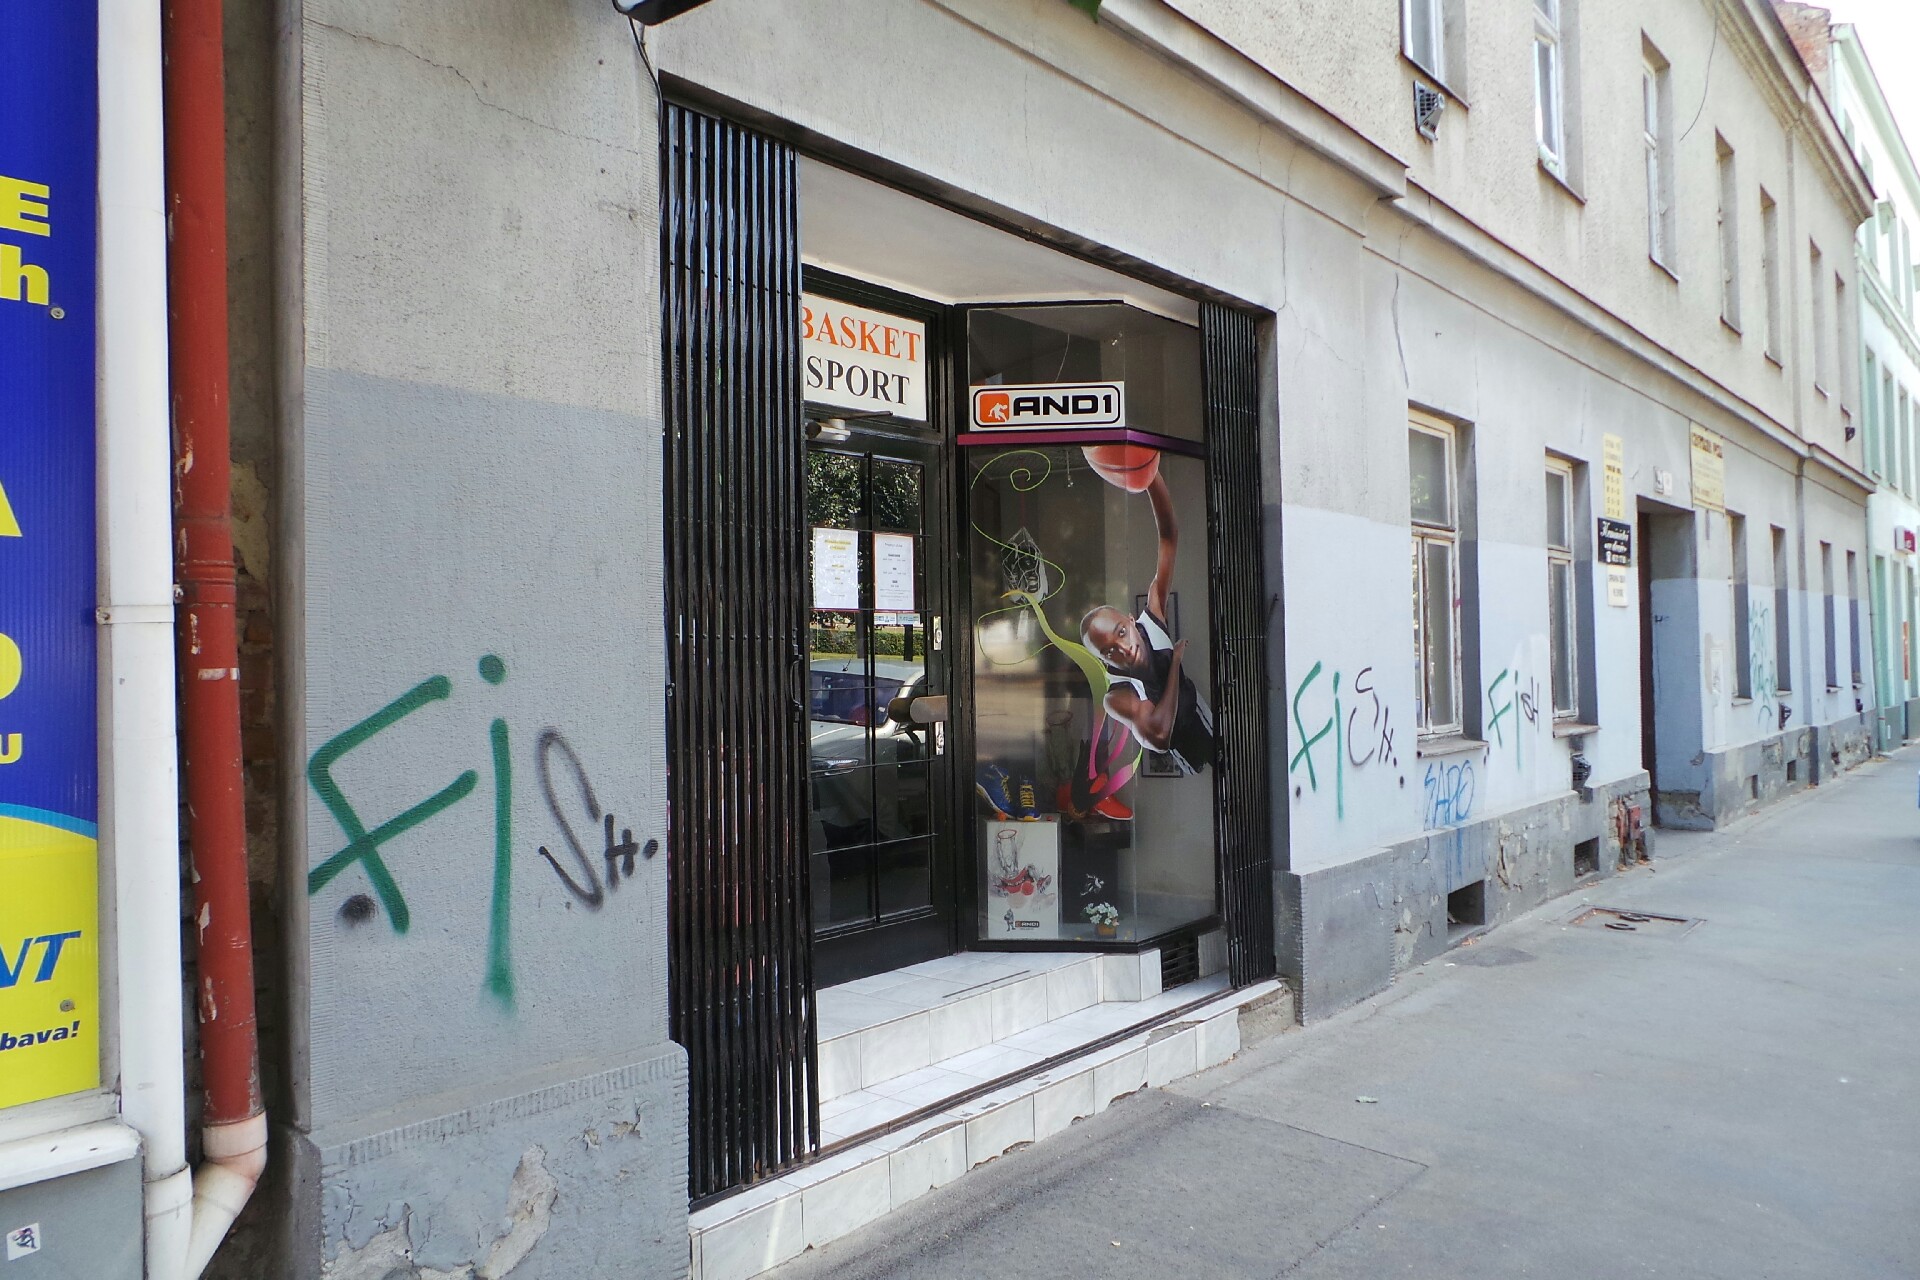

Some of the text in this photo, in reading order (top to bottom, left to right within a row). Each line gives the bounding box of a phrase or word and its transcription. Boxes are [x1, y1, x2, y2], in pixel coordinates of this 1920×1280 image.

[802, 306, 921, 362] BASKET
[806, 355, 911, 405] SPORT
[1012, 394, 1112, 417] AND1
